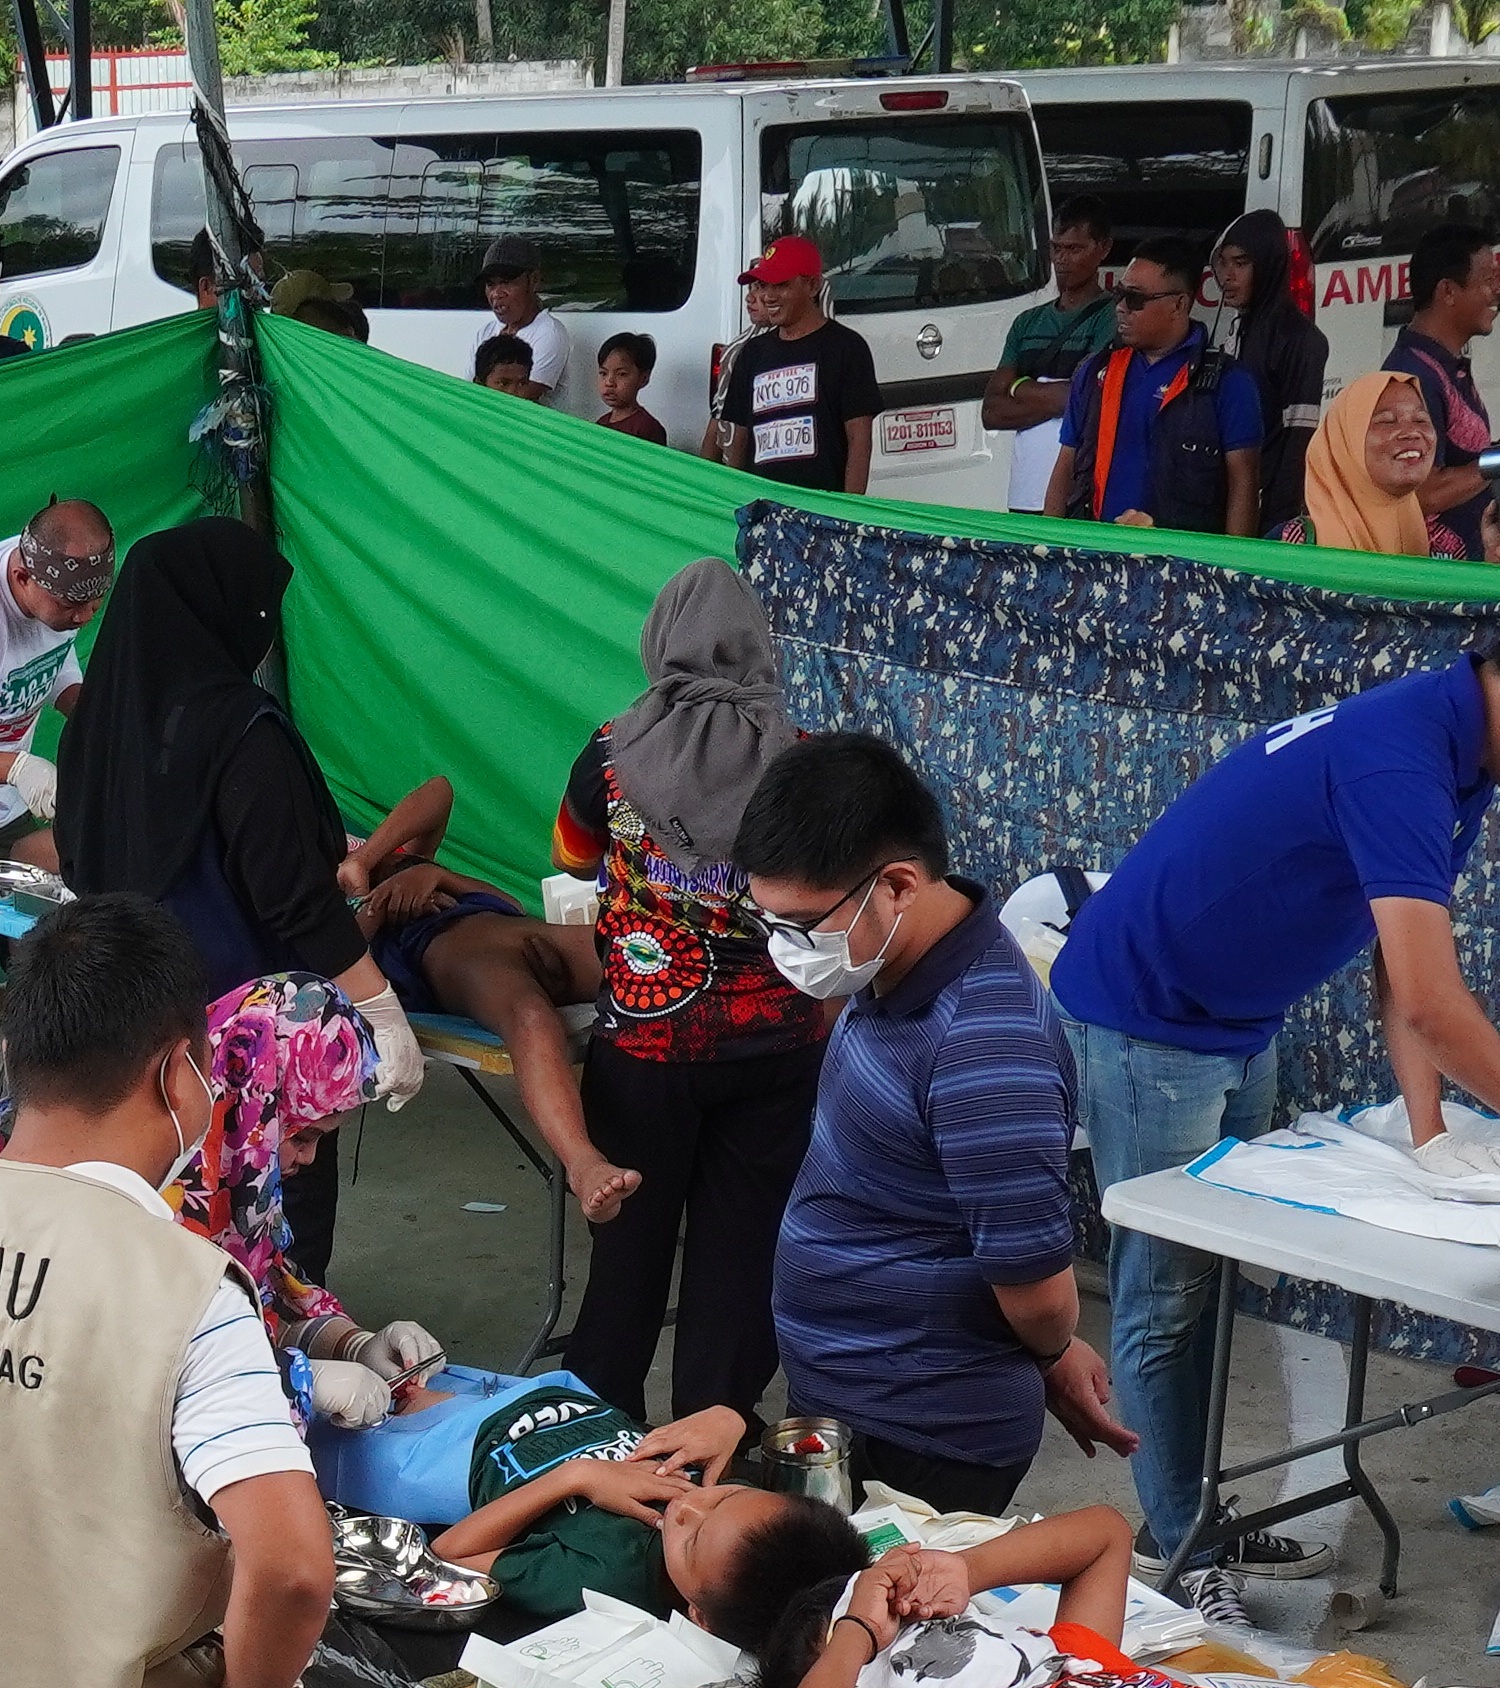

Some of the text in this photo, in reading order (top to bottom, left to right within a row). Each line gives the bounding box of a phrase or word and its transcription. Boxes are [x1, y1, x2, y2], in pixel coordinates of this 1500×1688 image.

[756, 381, 781, 404] NYC
[785, 375, 810, 397] 976
[784, 426, 811, 447] 976
